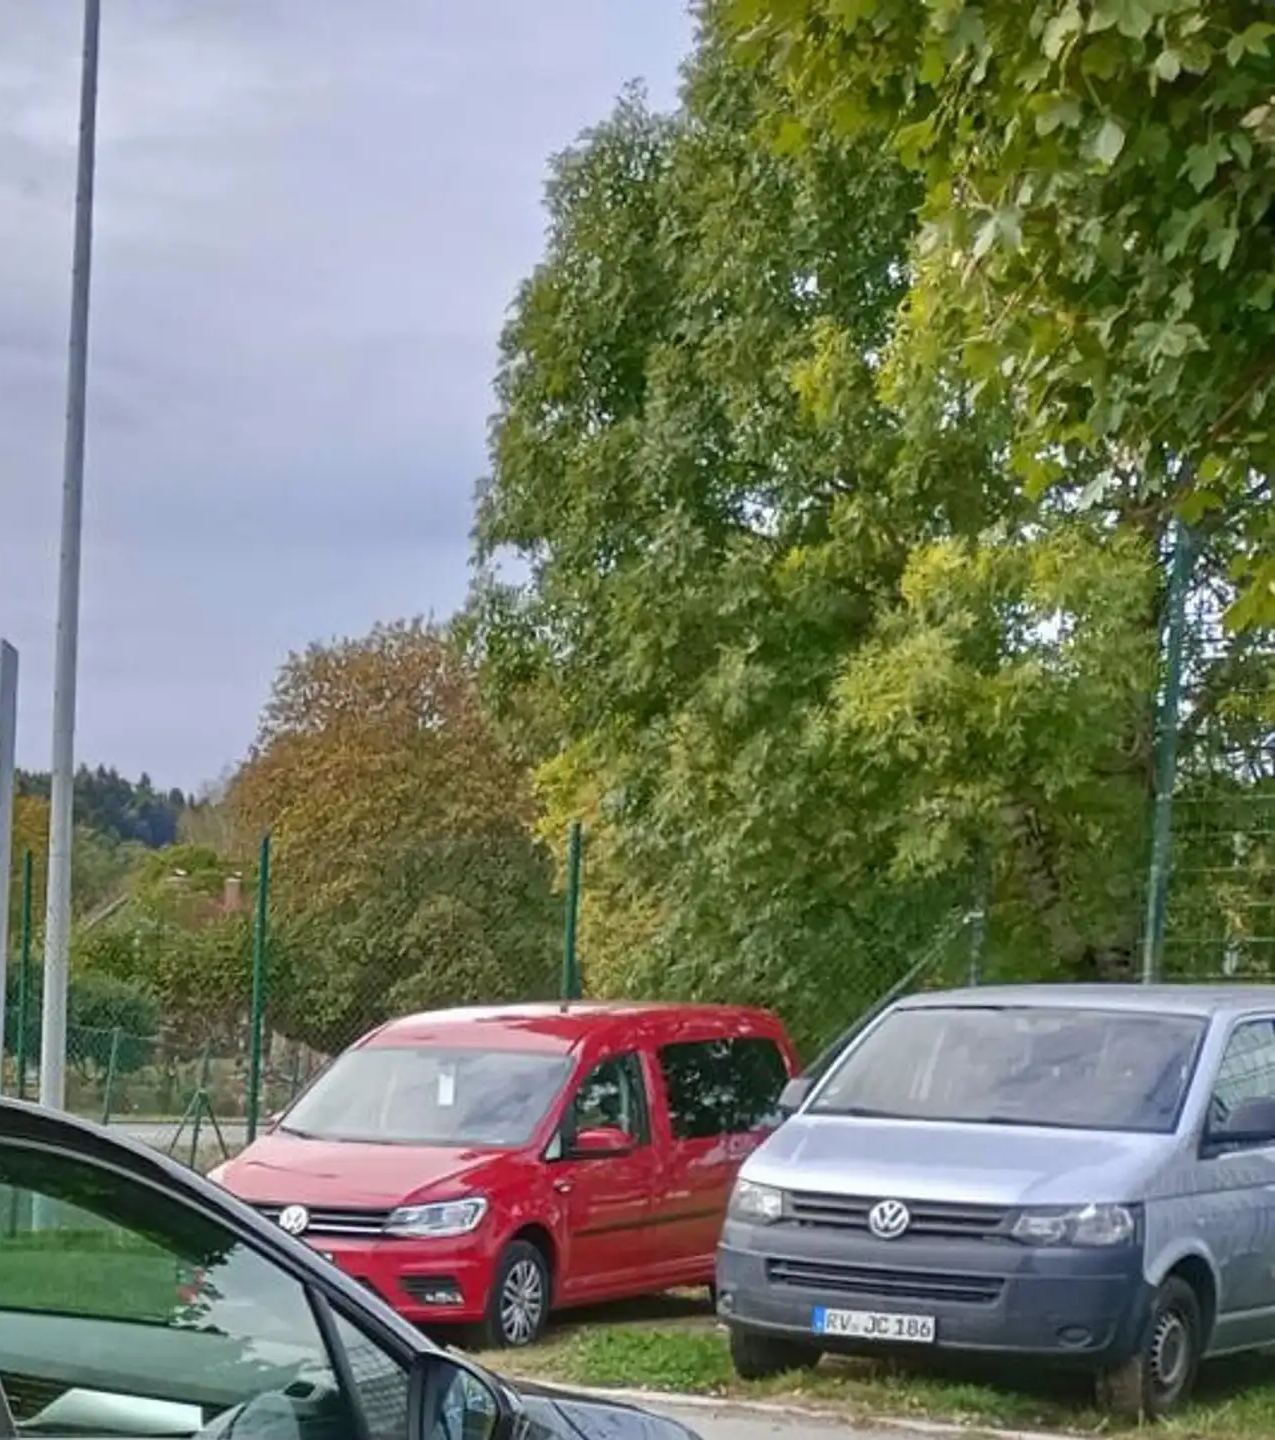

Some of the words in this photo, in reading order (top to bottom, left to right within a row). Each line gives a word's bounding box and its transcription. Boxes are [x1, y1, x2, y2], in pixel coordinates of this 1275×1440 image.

[826, 1312, 852, 1331] RV
[863, 1315, 889, 1334] JC
[895, 1318, 931, 1338] 186
